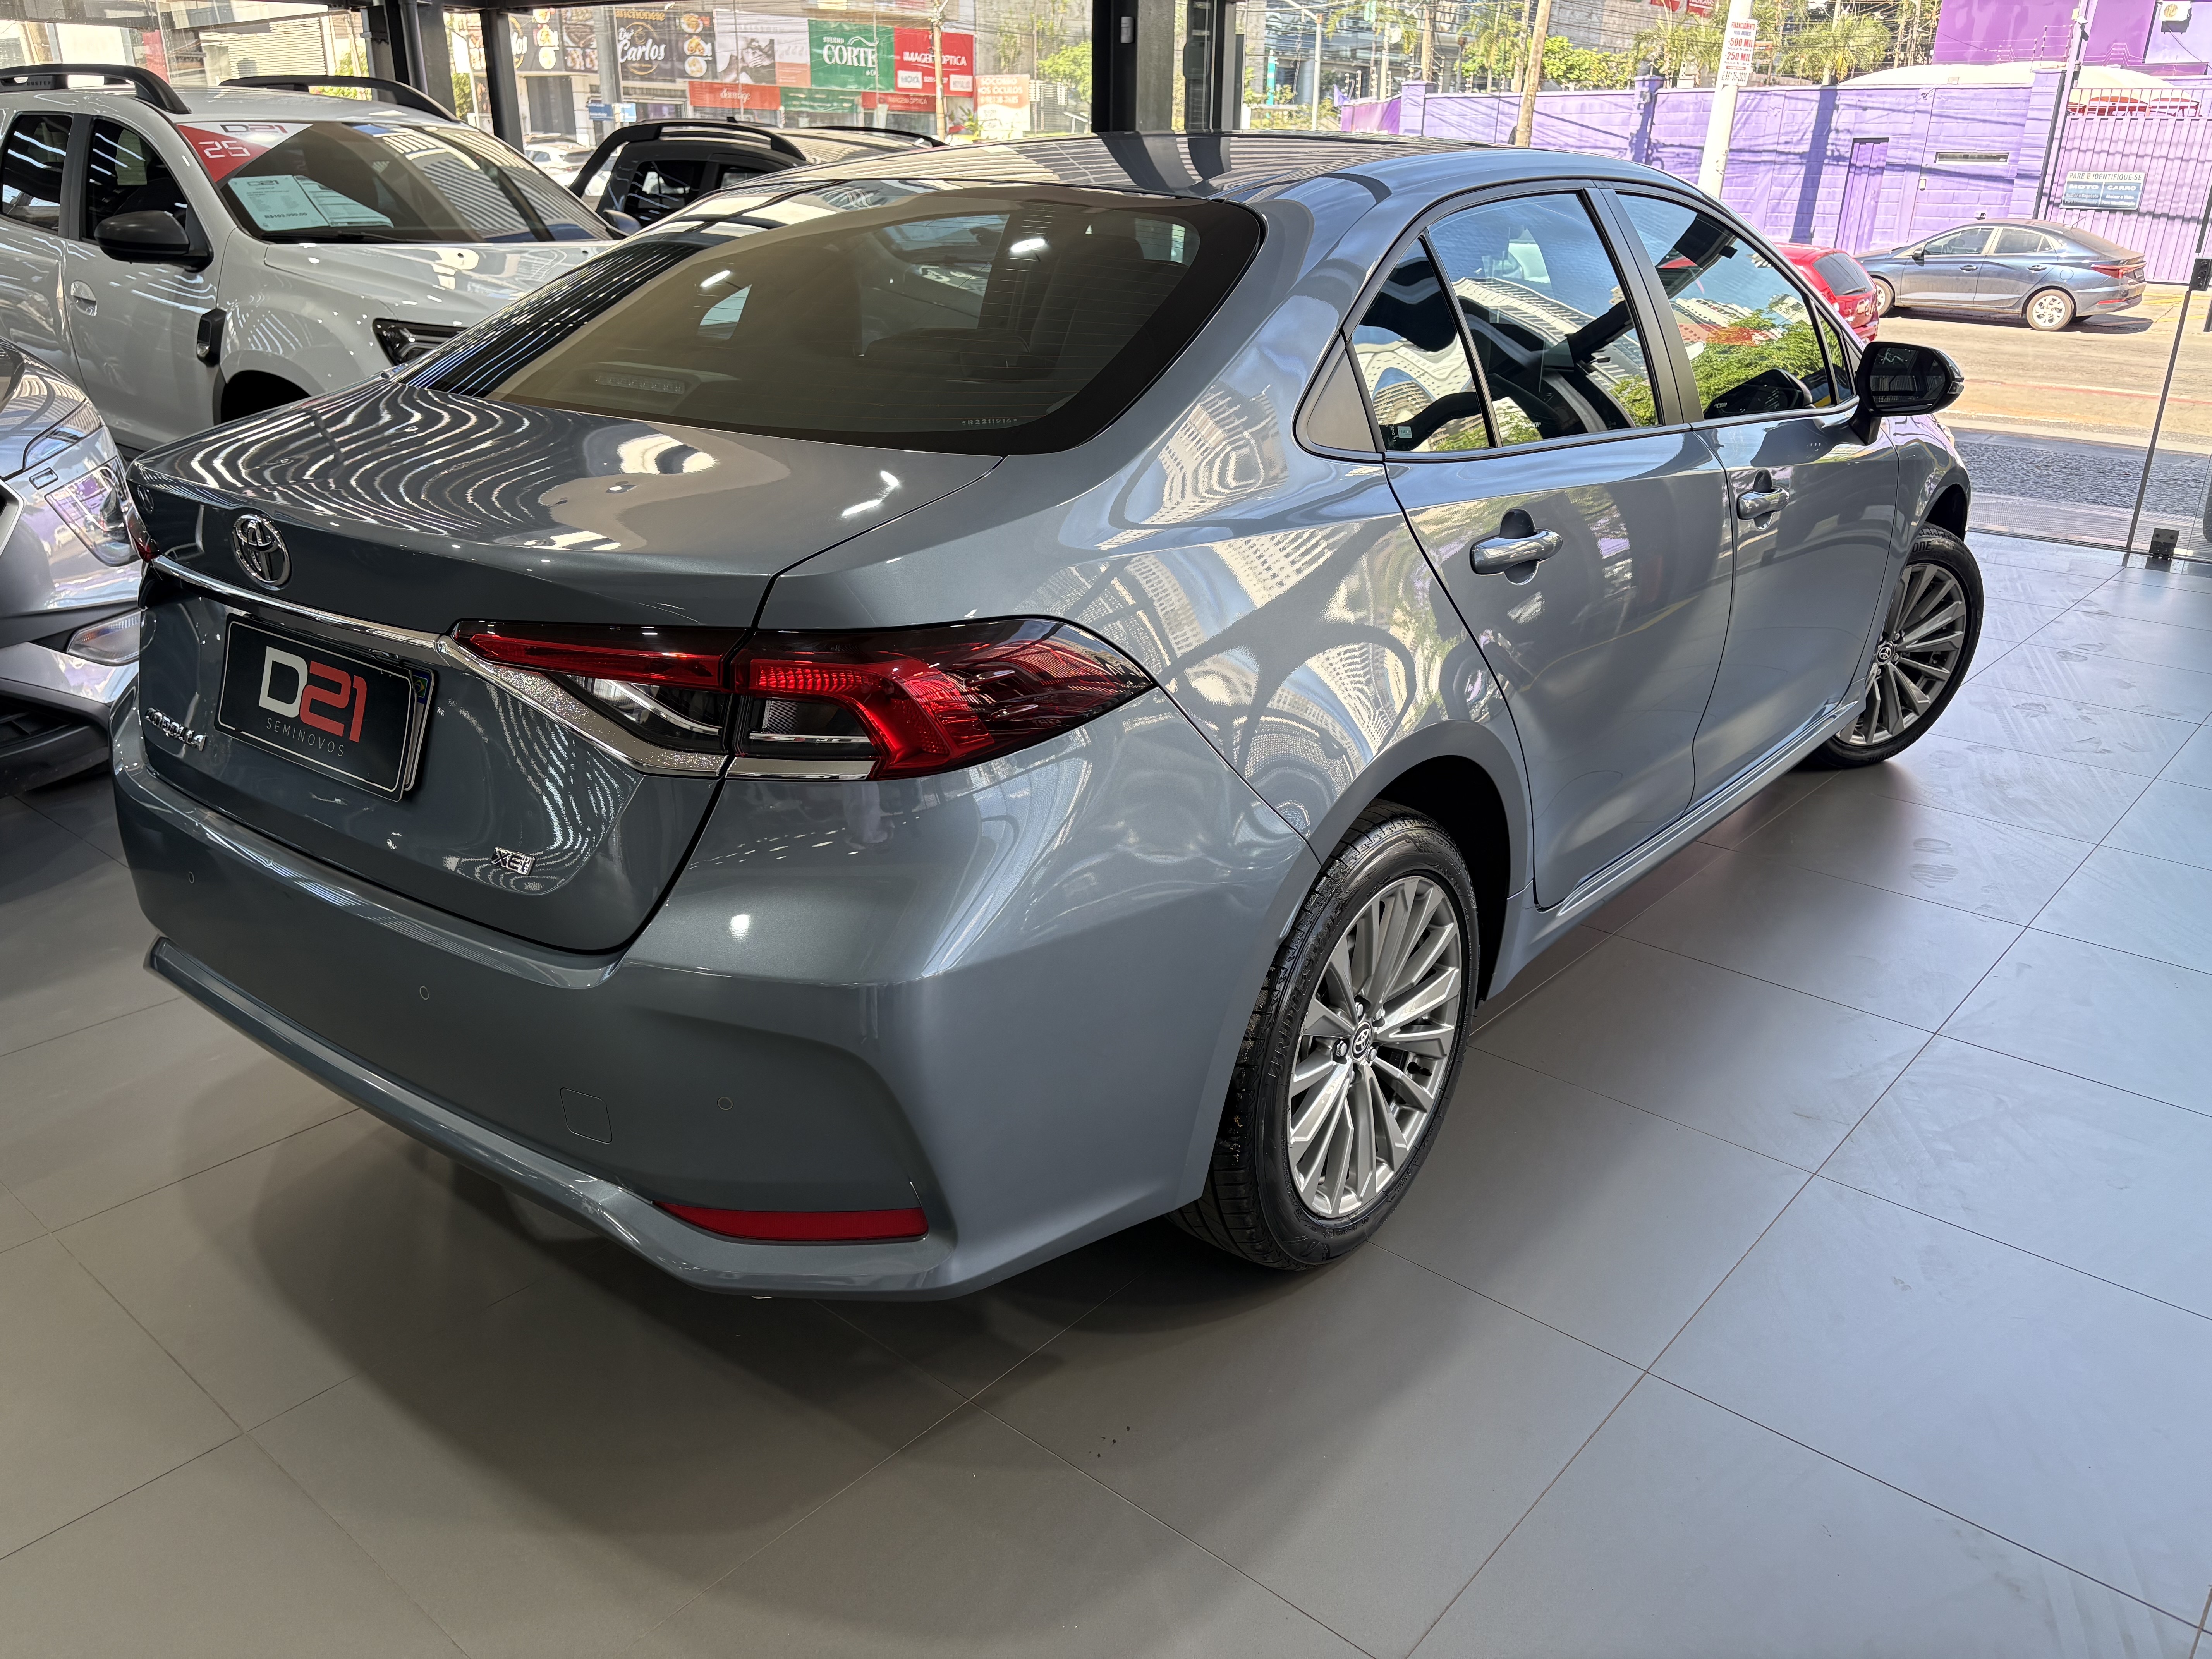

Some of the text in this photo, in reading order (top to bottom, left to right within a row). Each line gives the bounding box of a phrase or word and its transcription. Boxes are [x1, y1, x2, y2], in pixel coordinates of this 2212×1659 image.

[617, 39, 666, 63] Carlos
[1730, 38, 1753, 48] 500 MIL
[823, 44, 877, 67] CORTE
[903, 51, 935, 64] IMAGE
[1727, 52, 1750, 62] 250 MIL
[220, 124, 288, 134] D21
[198, 141, 251, 158] 25
[259, 646, 367, 743] D21
[266, 718, 344, 757] SEMINOVOS
